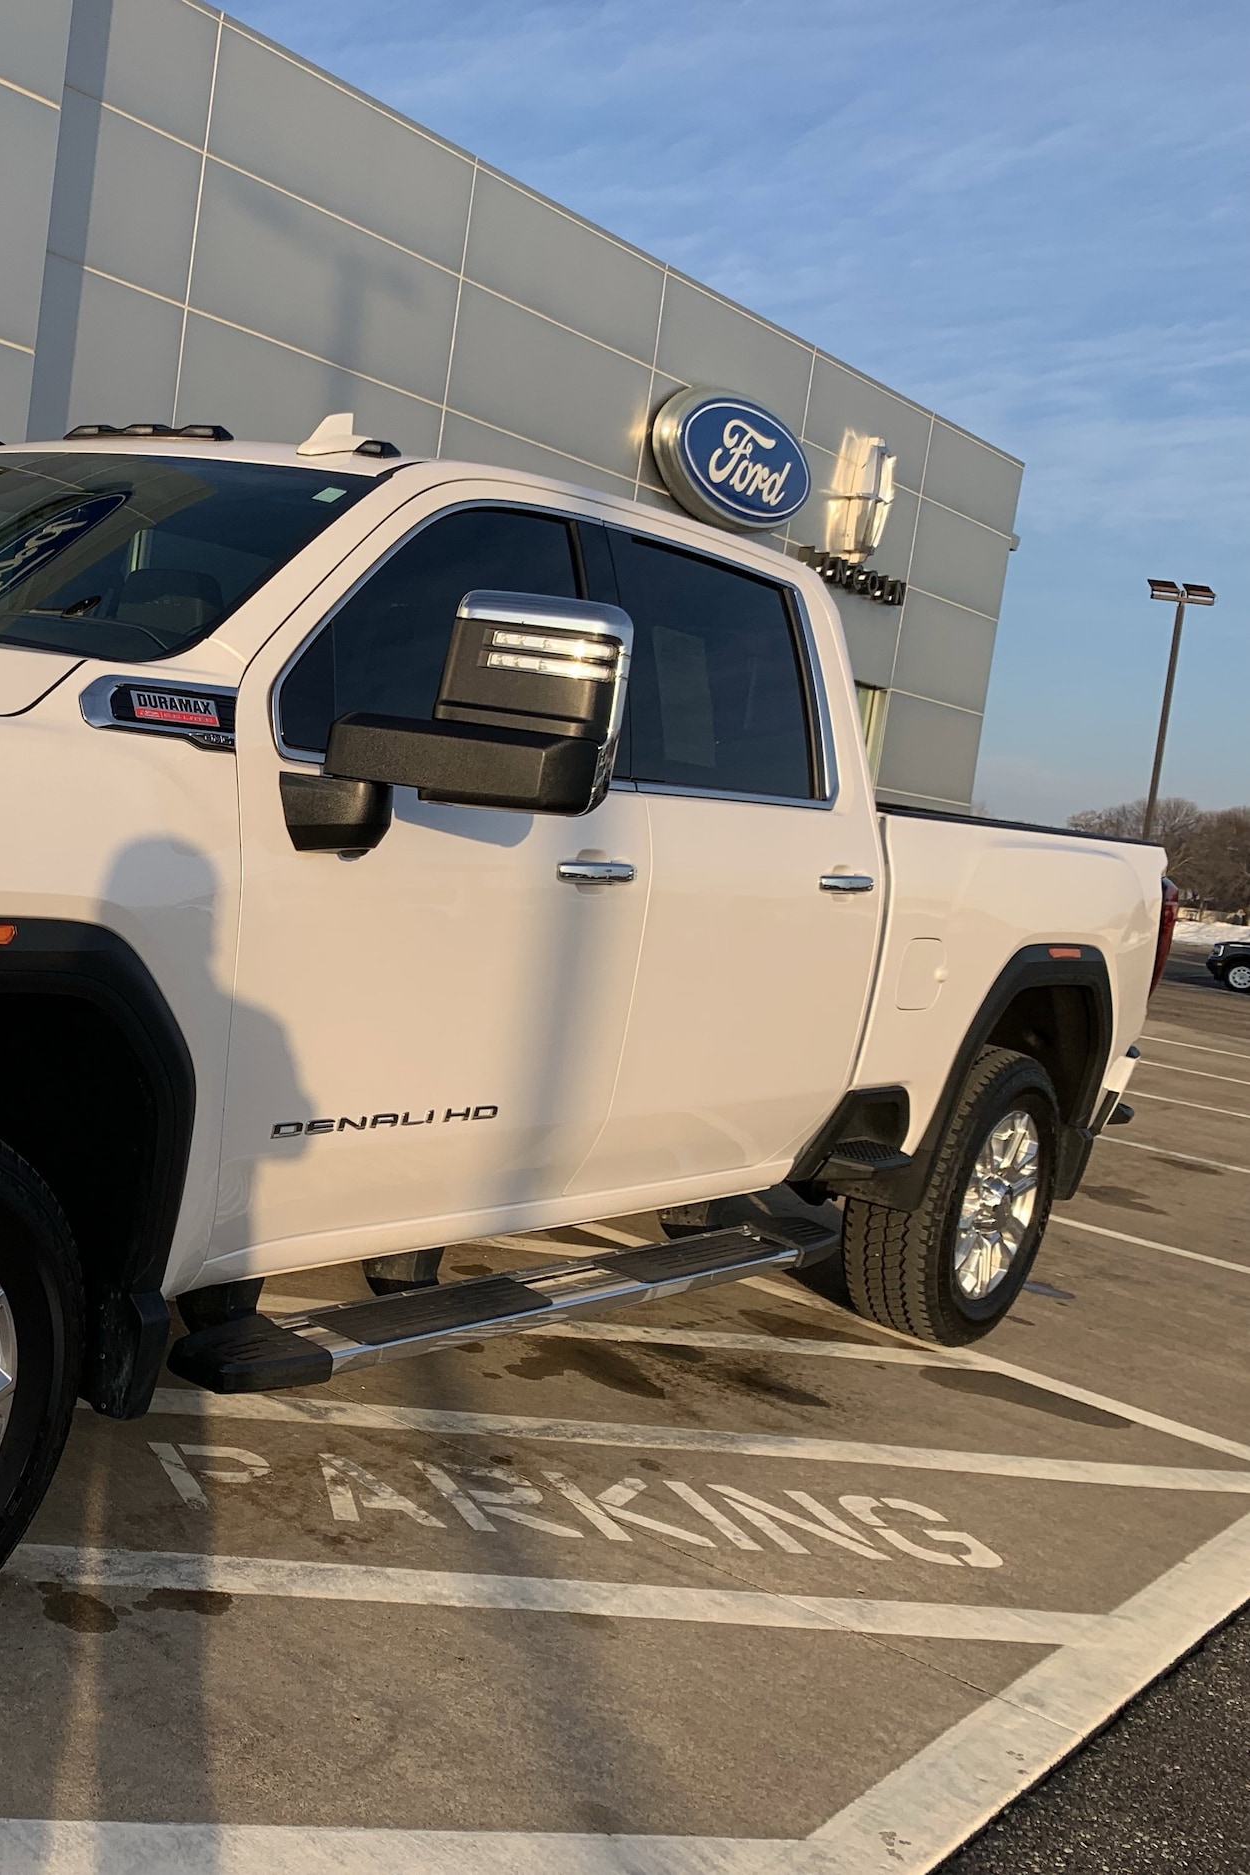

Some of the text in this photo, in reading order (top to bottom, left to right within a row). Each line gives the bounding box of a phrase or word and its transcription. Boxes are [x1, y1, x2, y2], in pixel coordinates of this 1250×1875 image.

[708, 418, 792, 507] Ford
[136, 692, 212, 715] DURAMAX
[270, 1105, 499, 1139] DENALI HD
[146, 1440, 1004, 1569] PARKING
